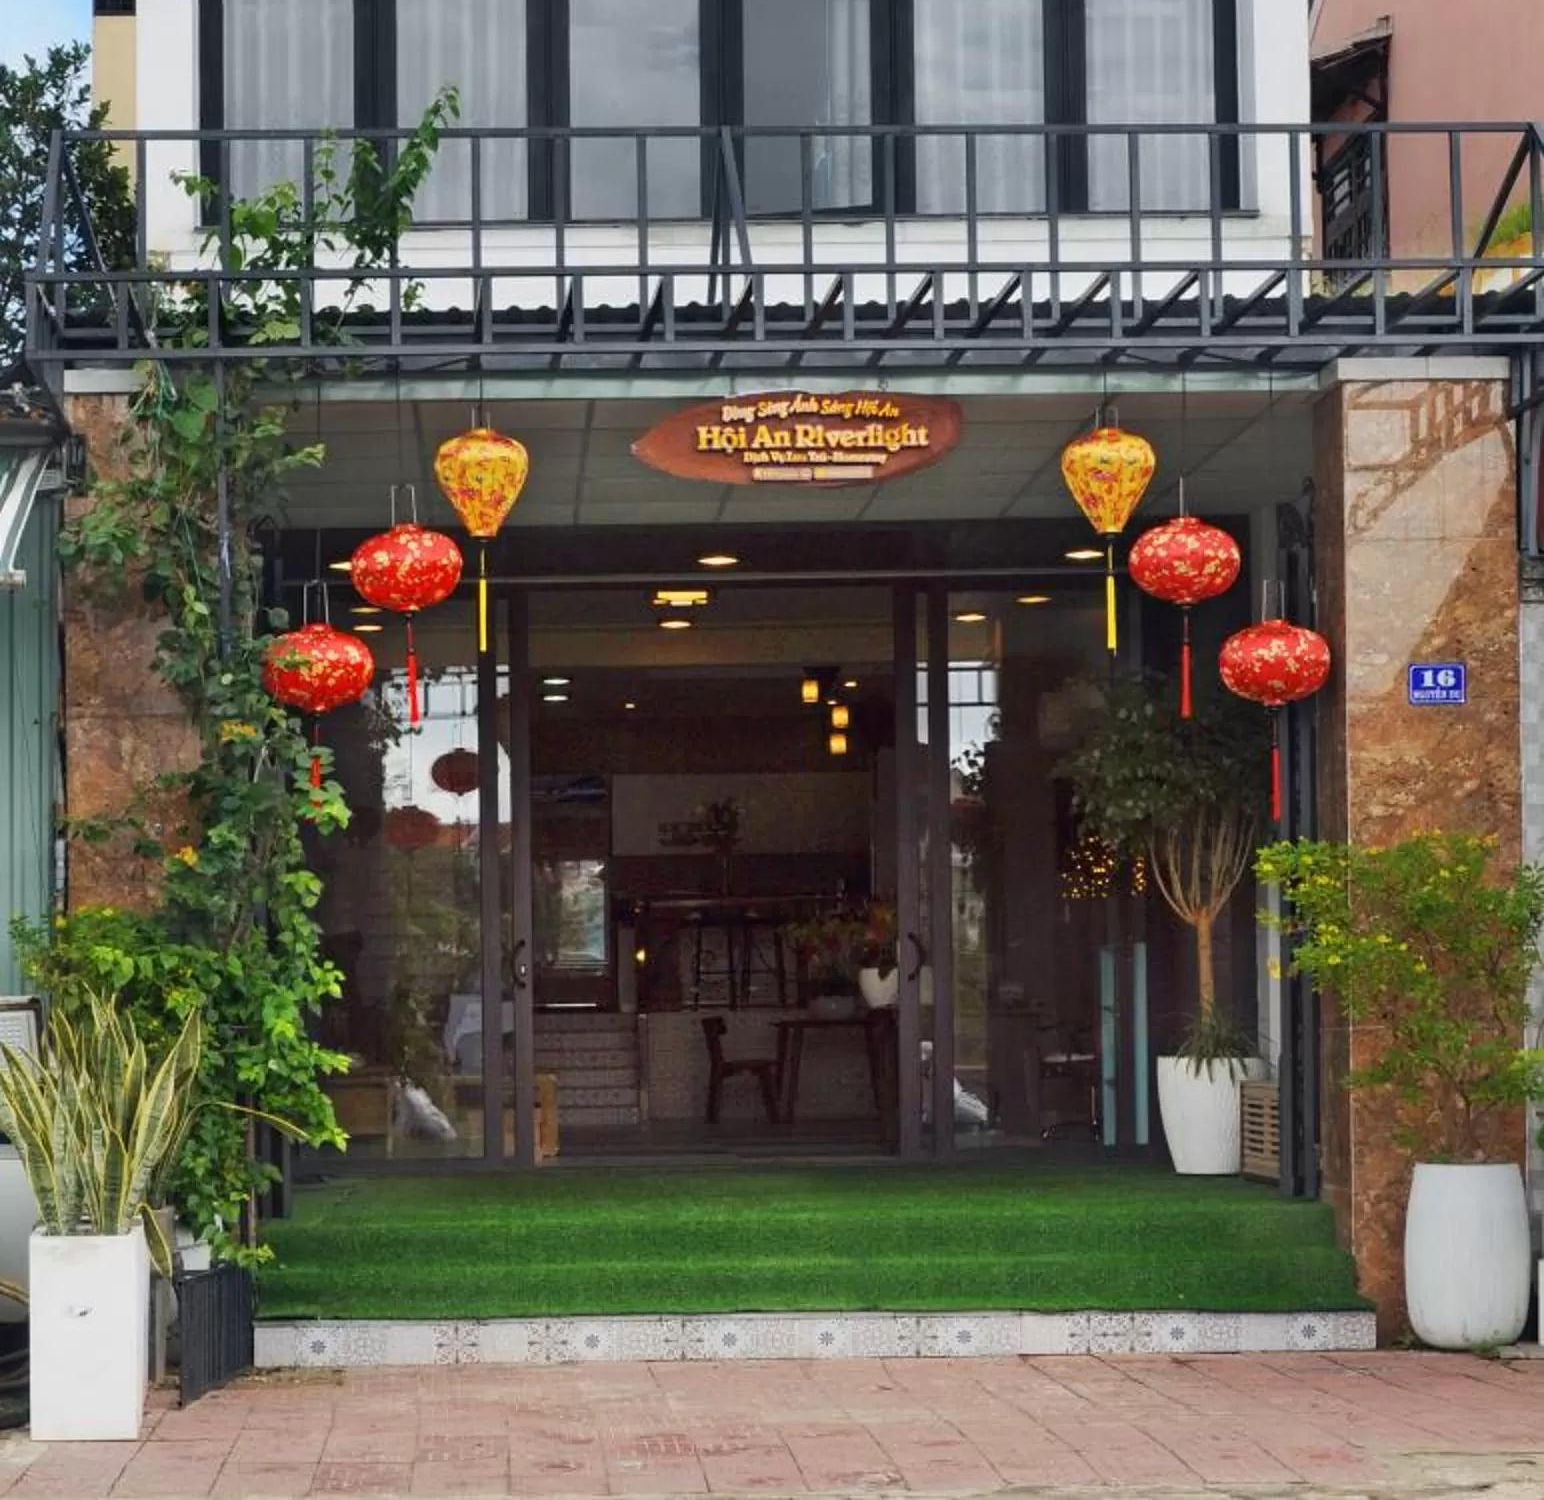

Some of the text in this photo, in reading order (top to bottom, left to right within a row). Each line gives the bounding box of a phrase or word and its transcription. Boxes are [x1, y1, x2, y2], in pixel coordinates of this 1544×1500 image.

[697, 423, 929, 453] Hội An Riverlight
[1420, 670, 1456, 687] 16
